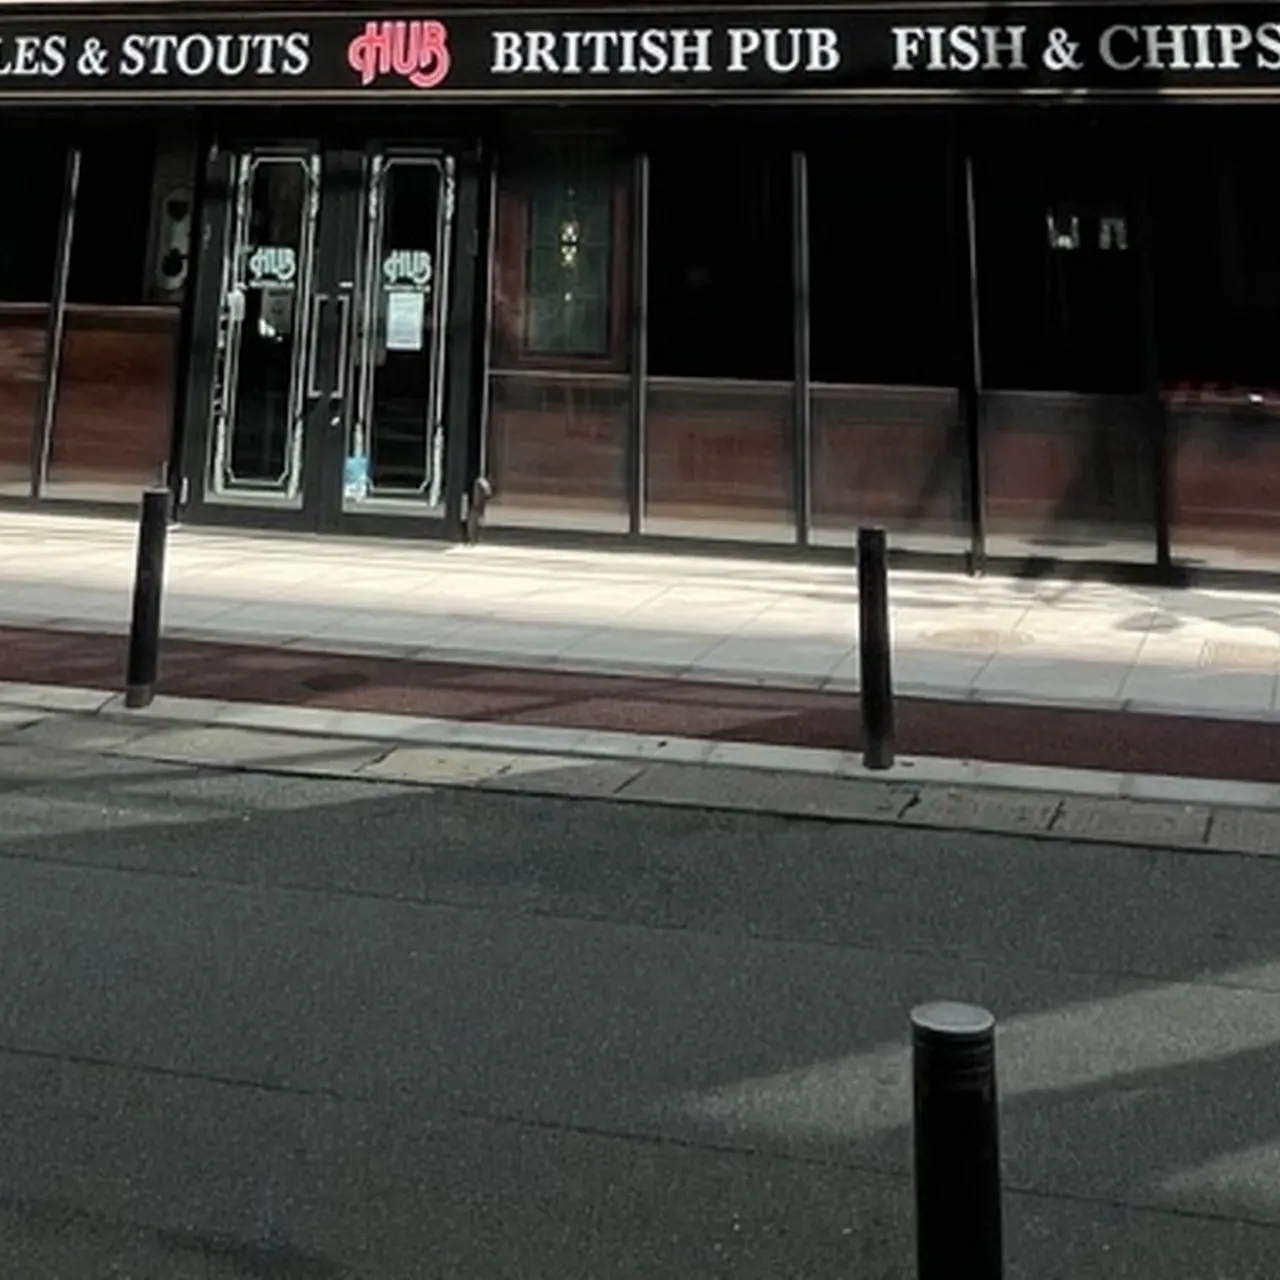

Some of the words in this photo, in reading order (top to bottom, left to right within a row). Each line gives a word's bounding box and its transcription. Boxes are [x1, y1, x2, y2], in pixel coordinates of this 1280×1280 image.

[77, 40, 110, 76] &
[120, 32, 310, 75] STOUTS
[347, 20, 451, 87] HUB
[491, 28, 712, 73] BRITISH
[727, 28, 840, 71] PUB
[891, 25, 1026, 71] FISH
[1042, 28, 1084, 71] &
[249, 246, 296, 281] HUB
[383, 249, 432, 284] HUB
